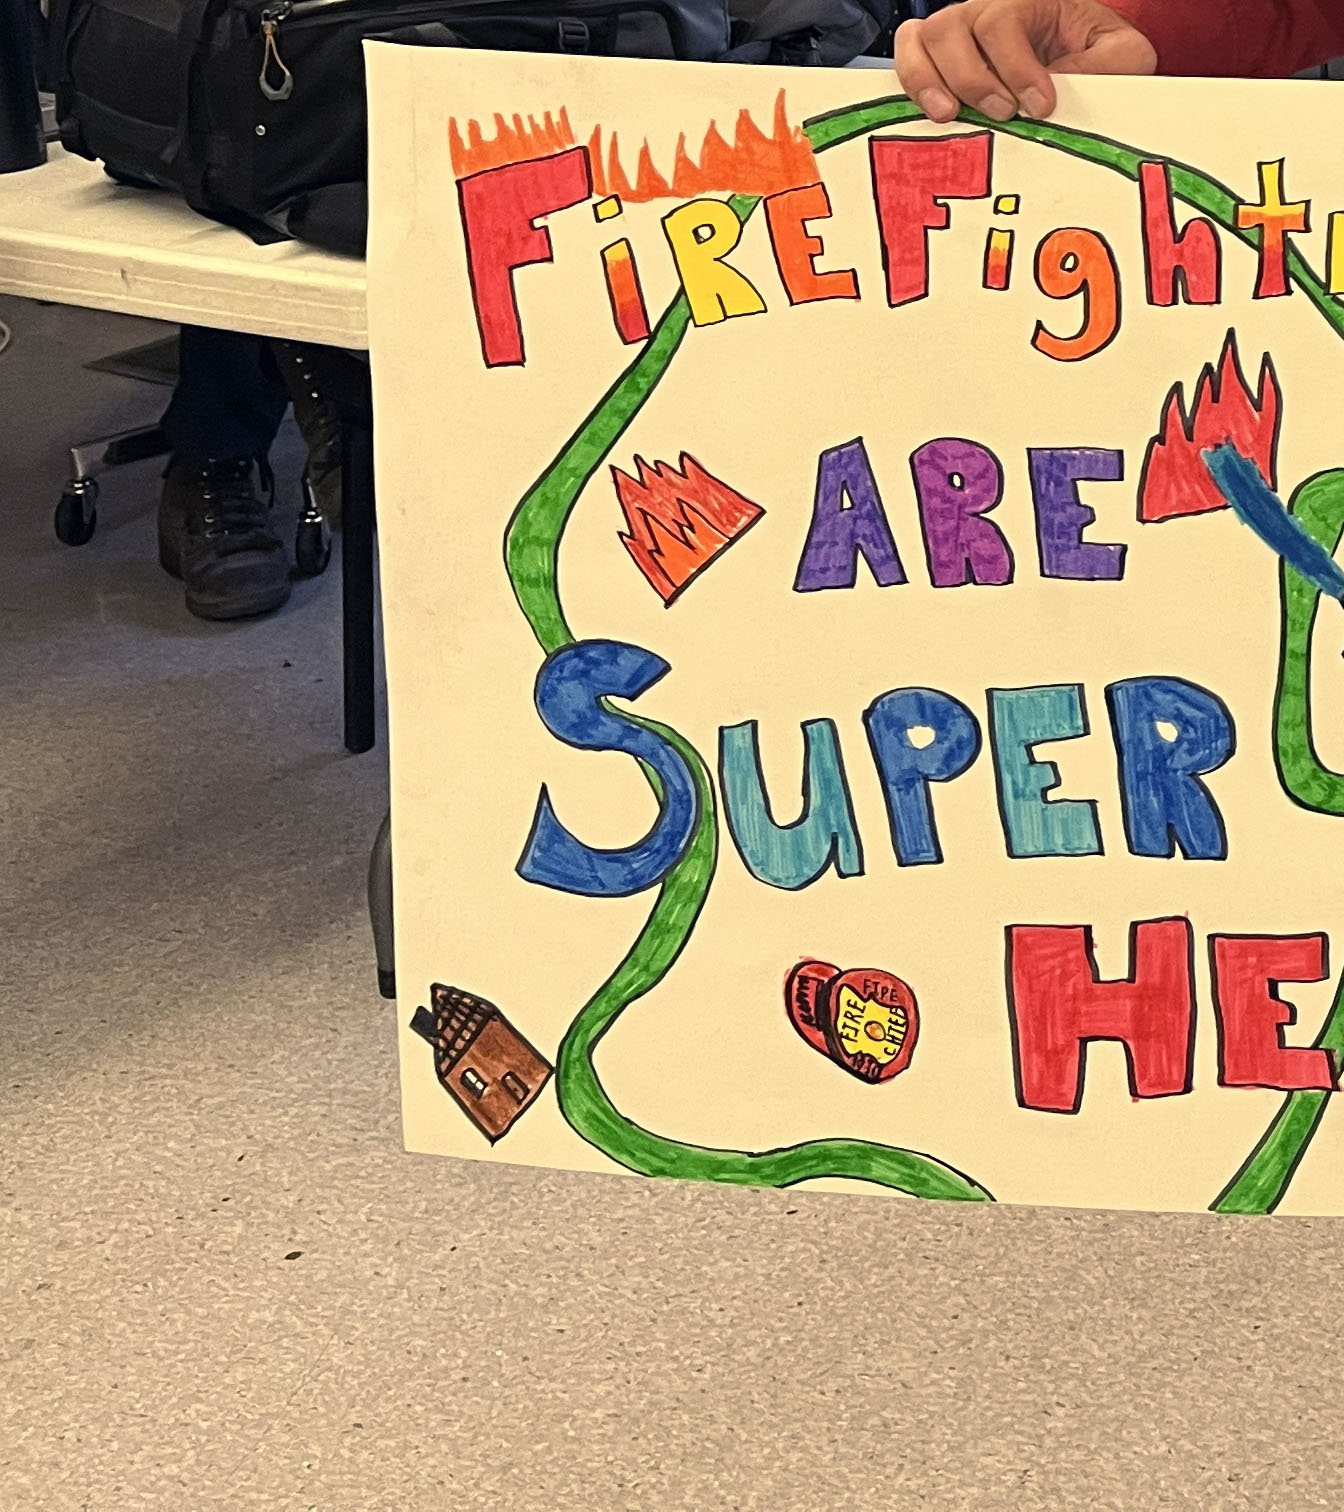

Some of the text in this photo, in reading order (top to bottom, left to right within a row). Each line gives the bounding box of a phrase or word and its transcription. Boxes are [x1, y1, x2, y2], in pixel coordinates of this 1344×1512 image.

[792, 436, 1127, 593] ARE
[515, 638, 1237, 898] SUPER
[840, 999, 867, 1043] FIRE
